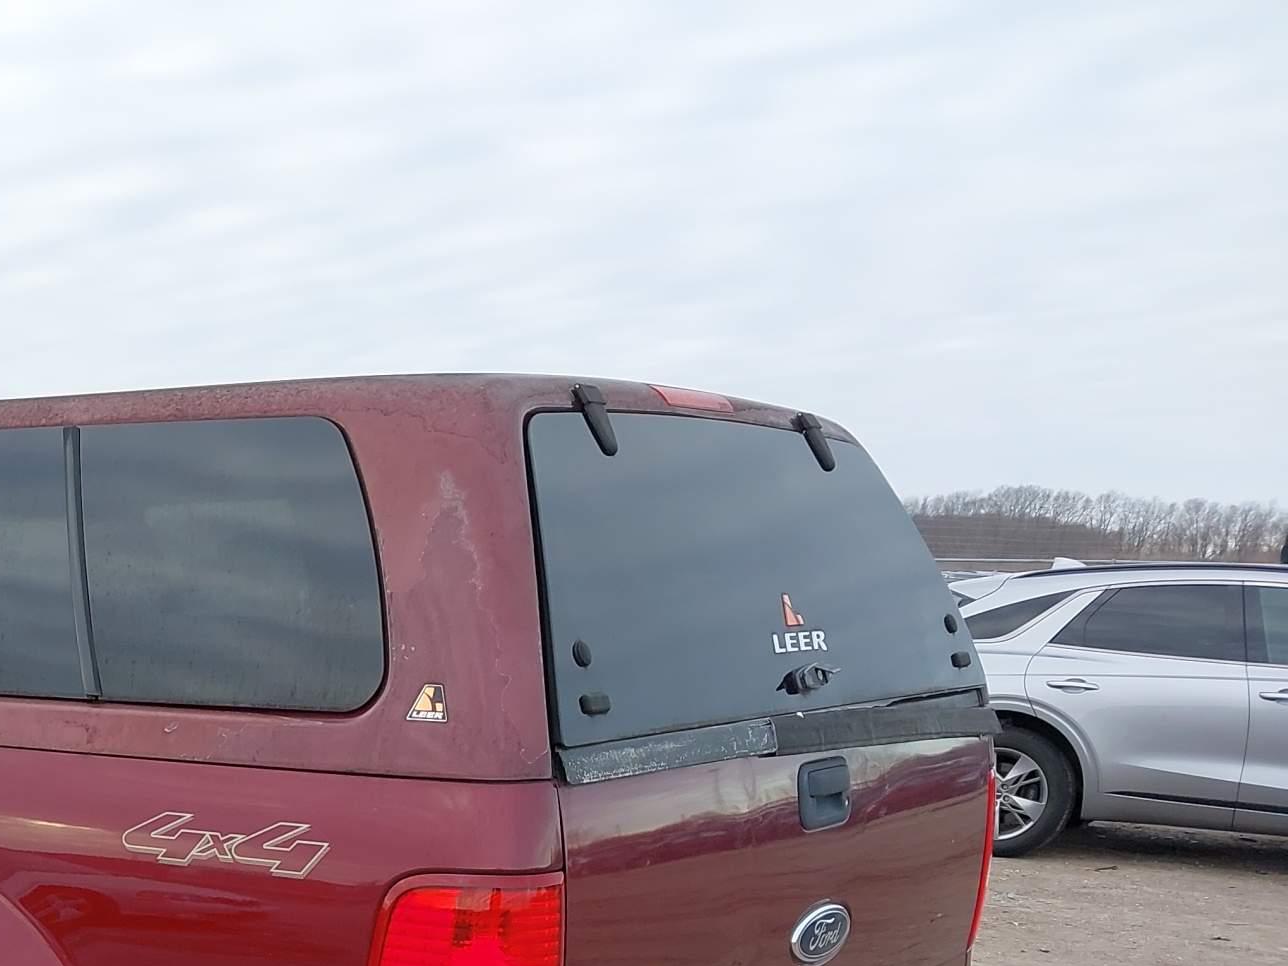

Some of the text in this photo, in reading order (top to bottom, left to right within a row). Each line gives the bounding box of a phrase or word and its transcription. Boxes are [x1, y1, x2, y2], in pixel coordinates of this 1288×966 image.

[772, 630, 828, 654] LEER
[411, 711, 444, 720] LEER
[122, 812, 330, 879] 4x4
[808, 917, 843, 951] Ford
